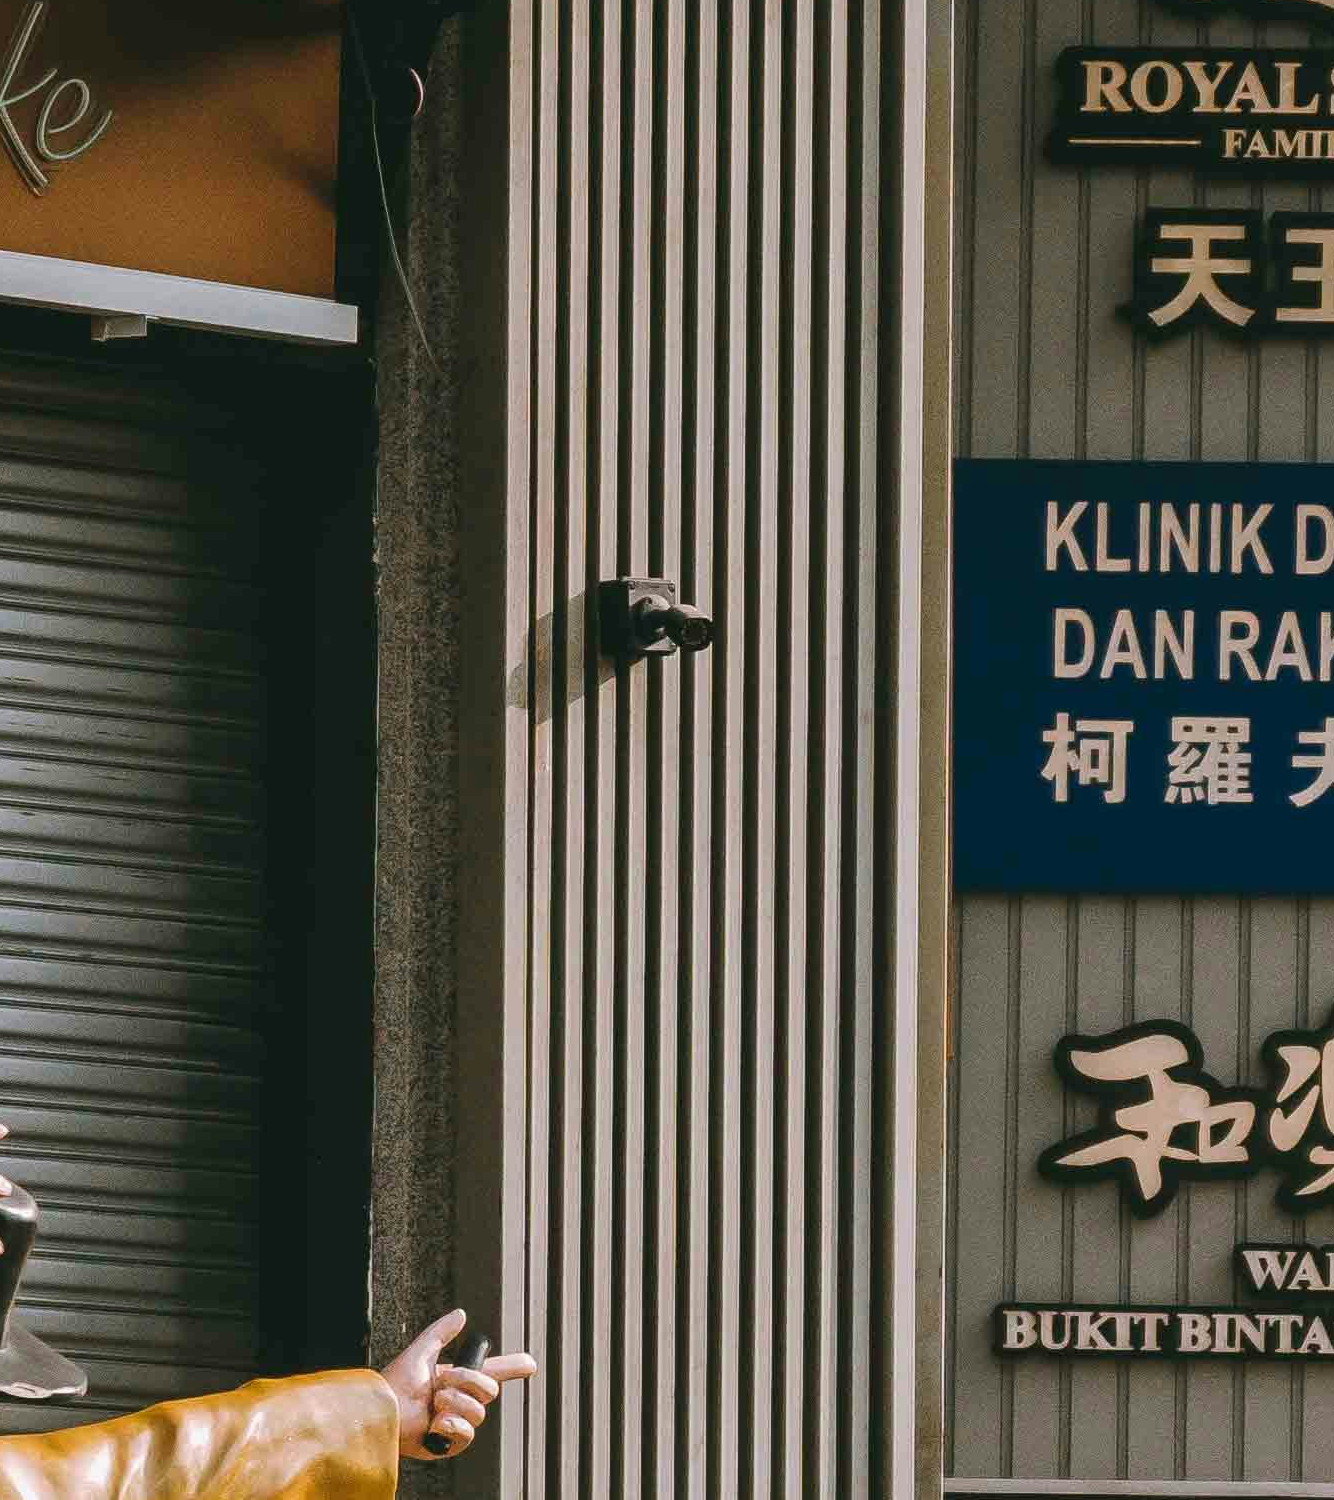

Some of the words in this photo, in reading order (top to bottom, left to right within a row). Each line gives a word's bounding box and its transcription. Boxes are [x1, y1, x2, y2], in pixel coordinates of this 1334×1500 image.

[1079, 60, 1319, 114] ROYAL
[1044, 499, 1275, 574] KLINIK
[1053, 608, 1196, 681] DAN
[1003, 1310, 1167, 1353] BUKIT
